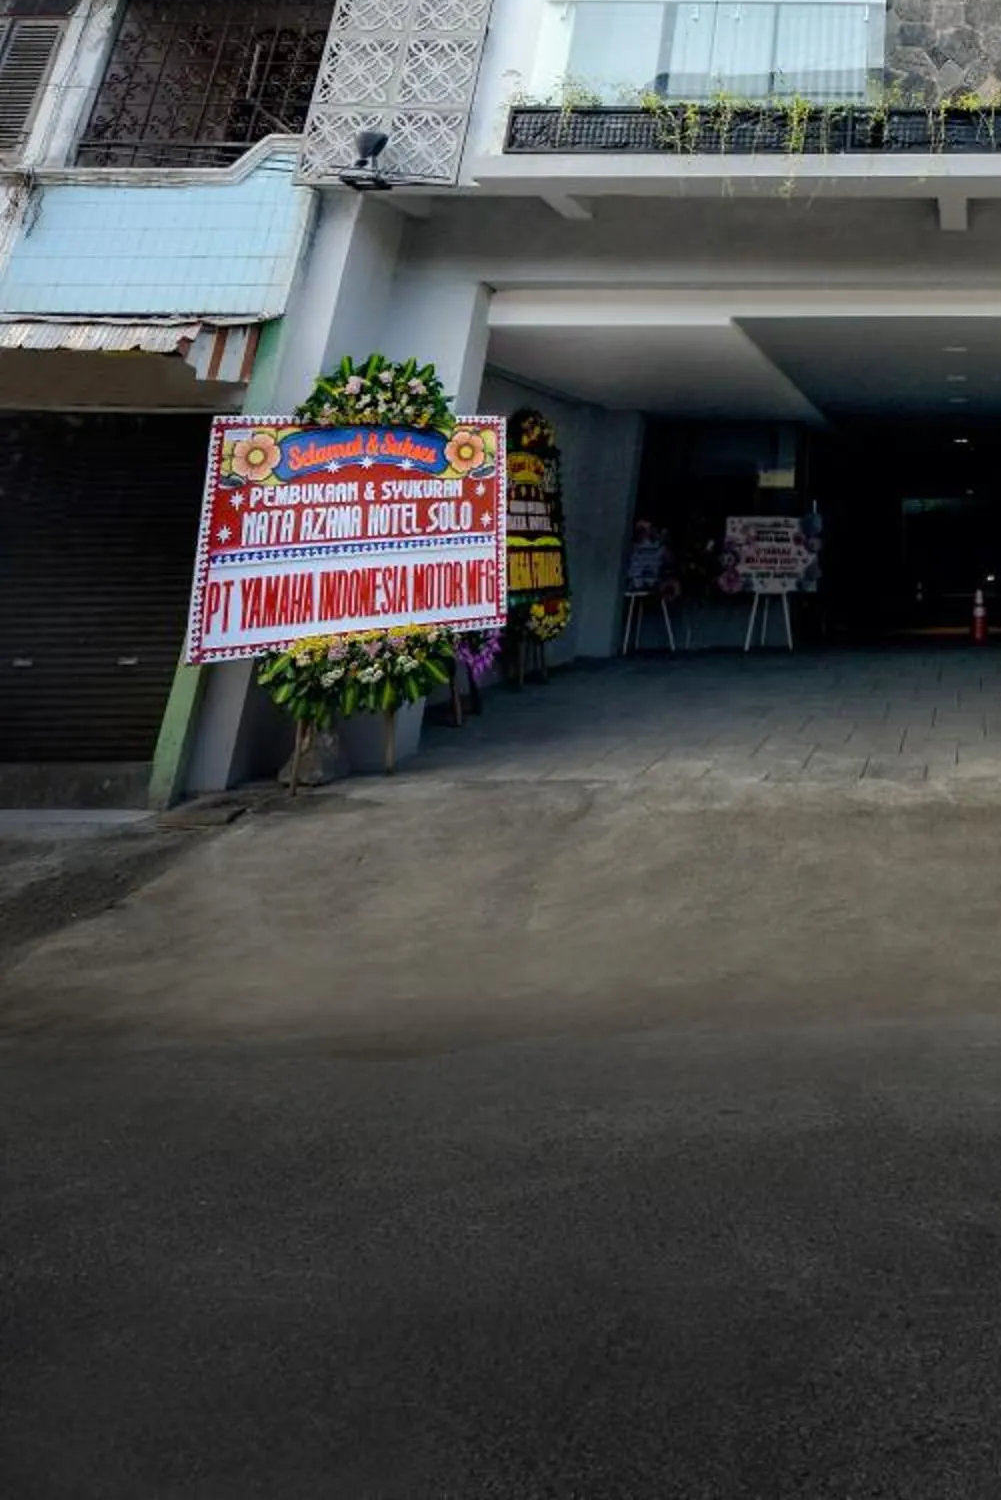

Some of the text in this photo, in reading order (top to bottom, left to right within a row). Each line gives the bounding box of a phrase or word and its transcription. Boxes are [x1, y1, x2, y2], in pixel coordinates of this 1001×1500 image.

[288, 431, 437, 471] Selamat & Sukses
[250, 480, 463, 508] PEMBUKAAN & SYUKURAN
[241, 508, 294, 547] NATA
[300, 503, 361, 541] AZANA
[367, 503, 421, 537] HOTEL
[425, 501, 473, 534] SOLO
[204, 580, 234, 635] PT
[240, 571, 313, 631] YAMAHA
[318, 566, 408, 621] INDONESIA
[412, 560, 464, 612] MOTOR
